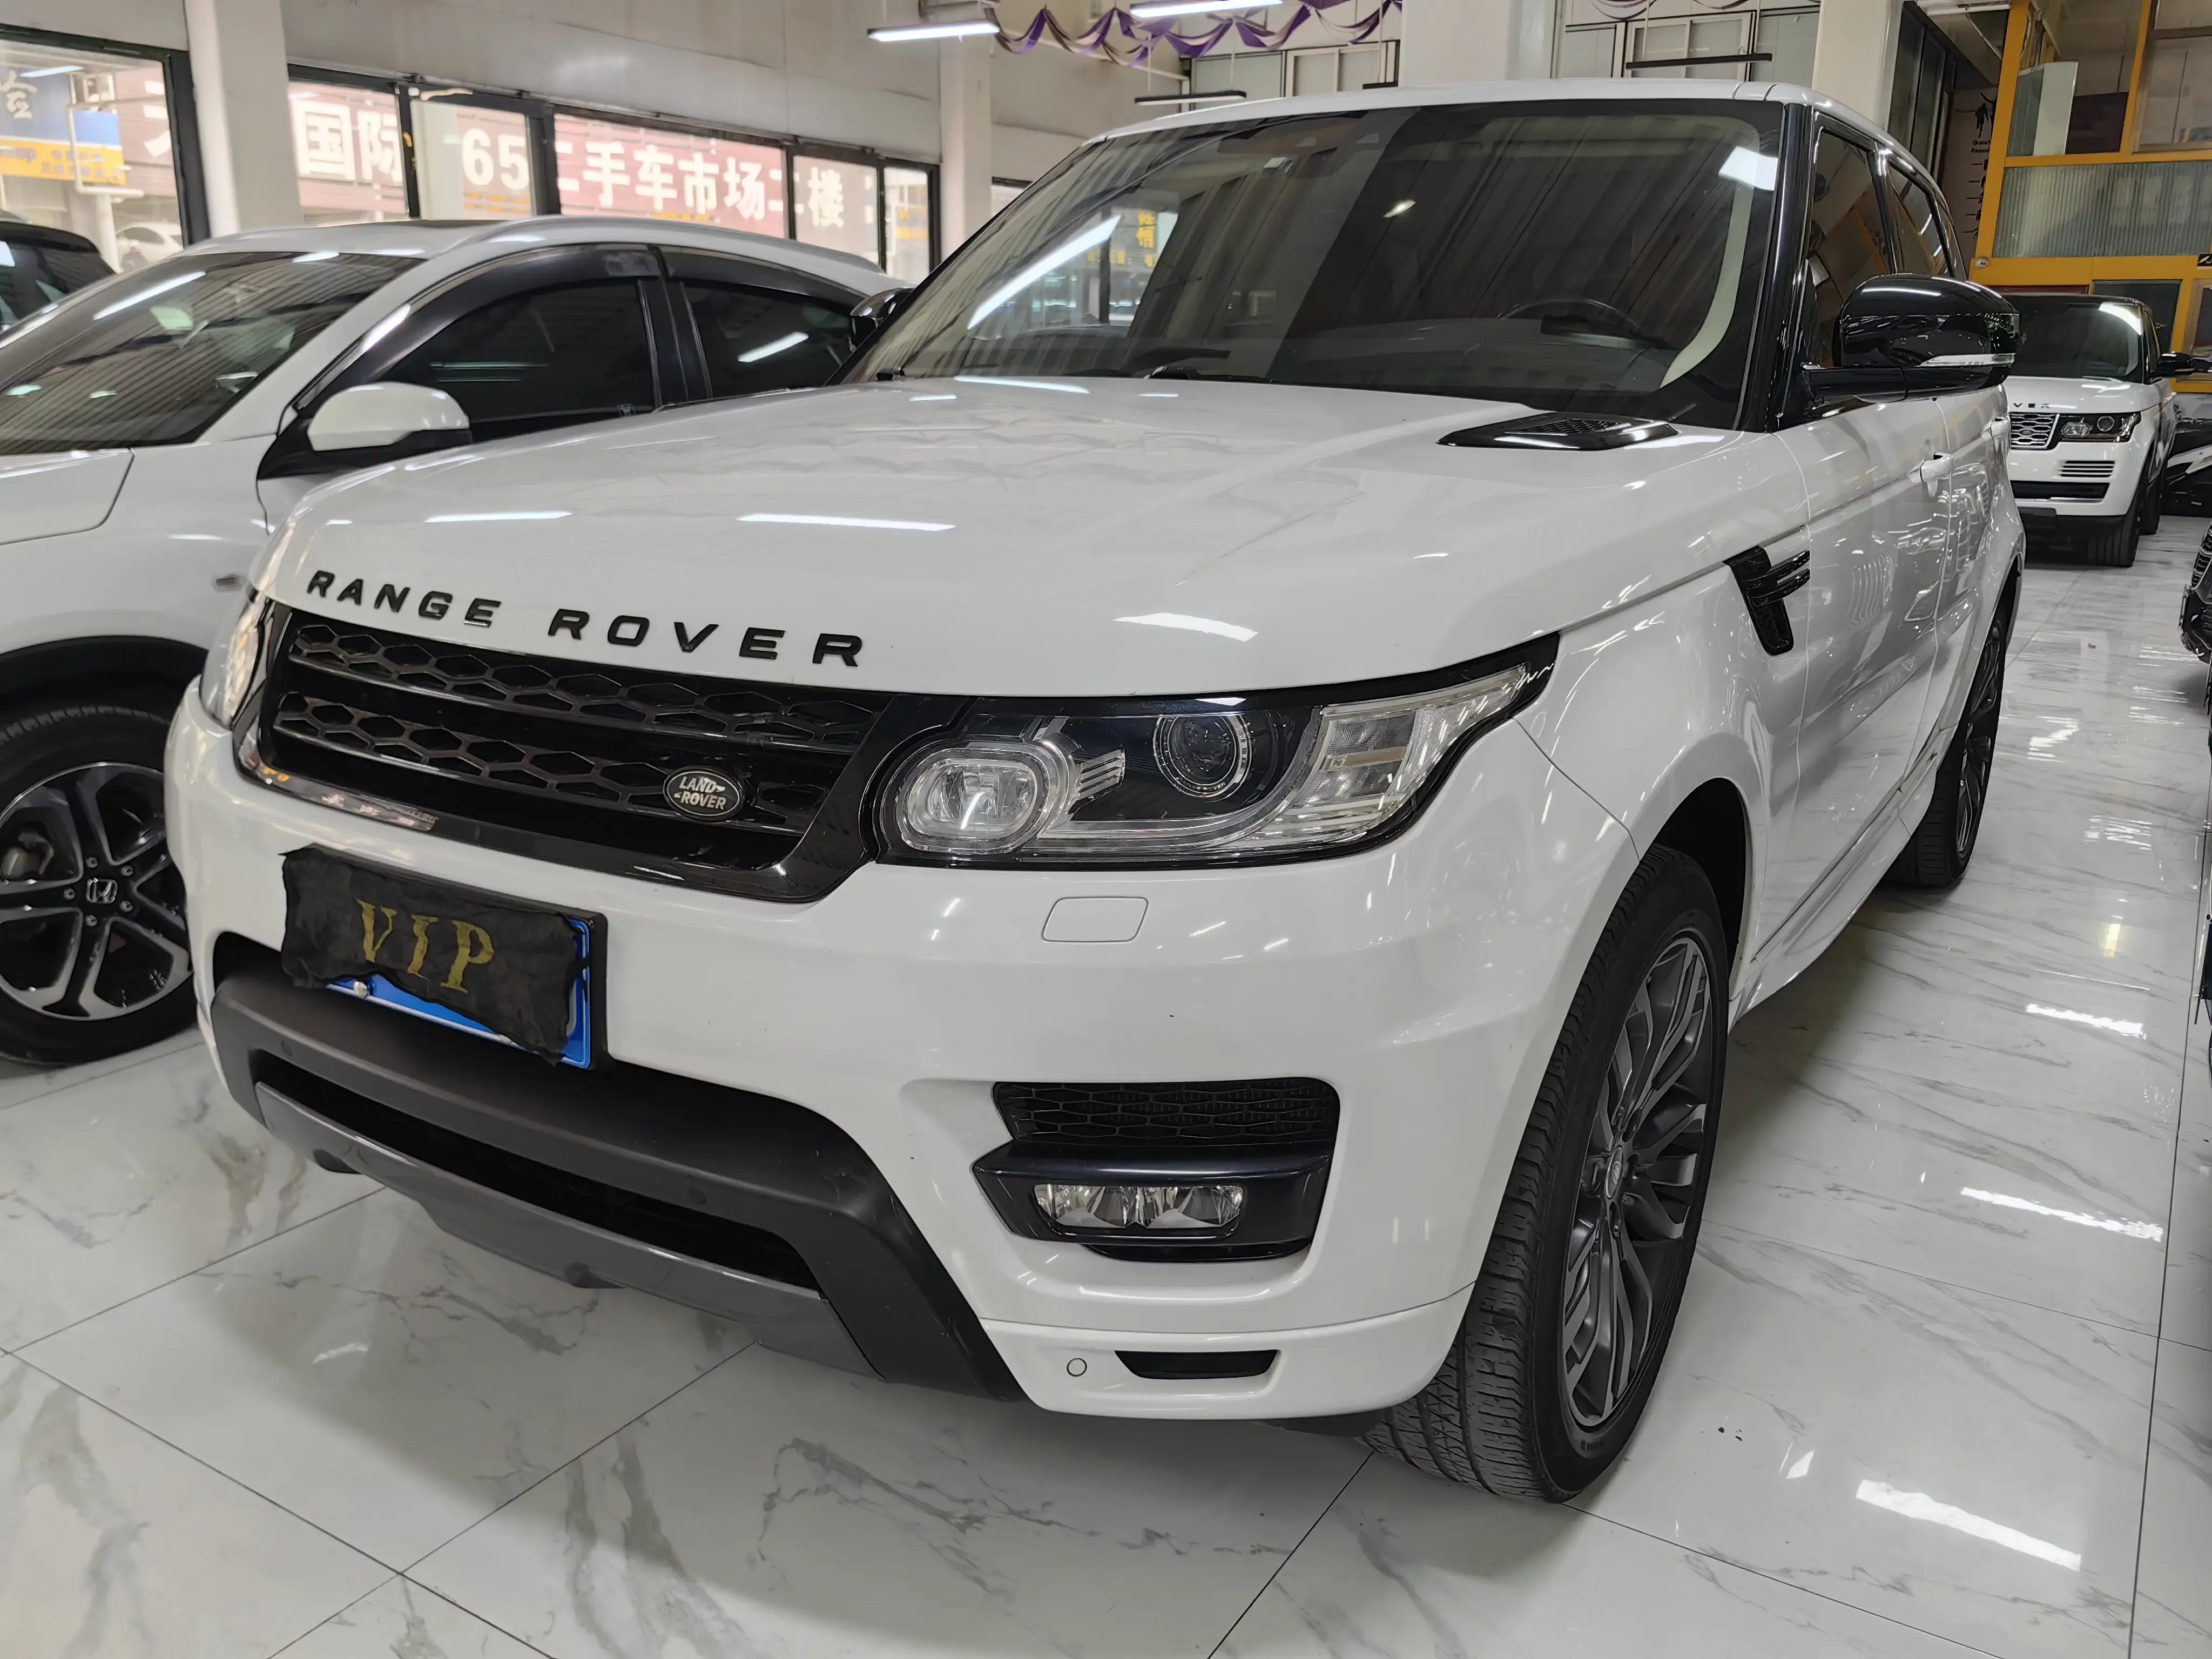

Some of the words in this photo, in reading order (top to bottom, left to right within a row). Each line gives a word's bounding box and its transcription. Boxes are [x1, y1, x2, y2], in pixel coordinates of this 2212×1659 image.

[291, 98, 403, 183] 国际
[462, 128, 530, 191] 65
[306, 569, 502, 628] RANGE
[547, 608, 863, 668] ROVER
[679, 776, 717, 793] LAND
[680, 791, 726, 810] ROVER
[1203, 781, 1226, 791] ROVER
[356, 898, 495, 994] VIP
